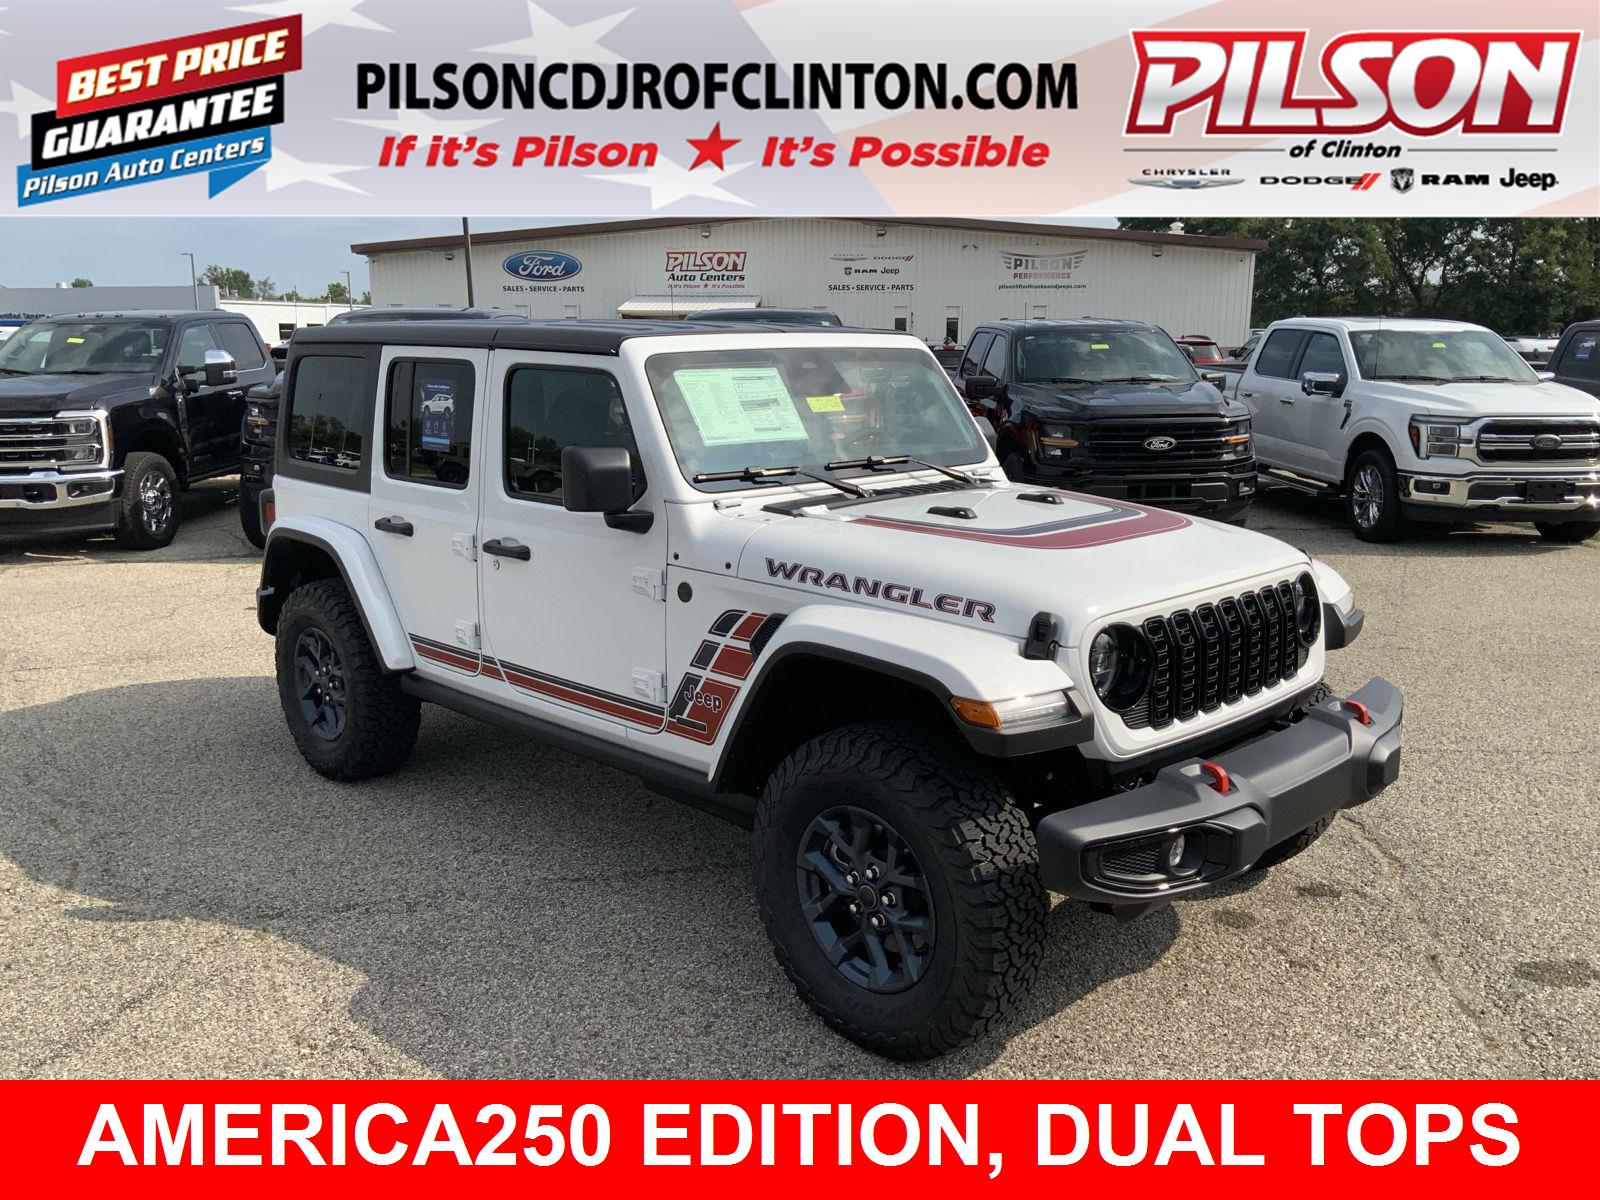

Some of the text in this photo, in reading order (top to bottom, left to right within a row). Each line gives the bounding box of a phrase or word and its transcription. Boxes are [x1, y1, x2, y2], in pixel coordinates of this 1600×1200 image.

[519, 255, 565, 276] Ford
[666, 252, 746, 272] PILSON
[1013, 257, 1073, 271] PILSON
[667, 273, 746, 282] Auto Centers
[881, 266, 900, 275] Jeep
[503, 285, 585, 293] SALES SERVICE PARTS
[1150, 440, 1170, 450] Ford
[765, 557, 996, 623] WRANGLER
[684, 684, 722, 713] Jeep
